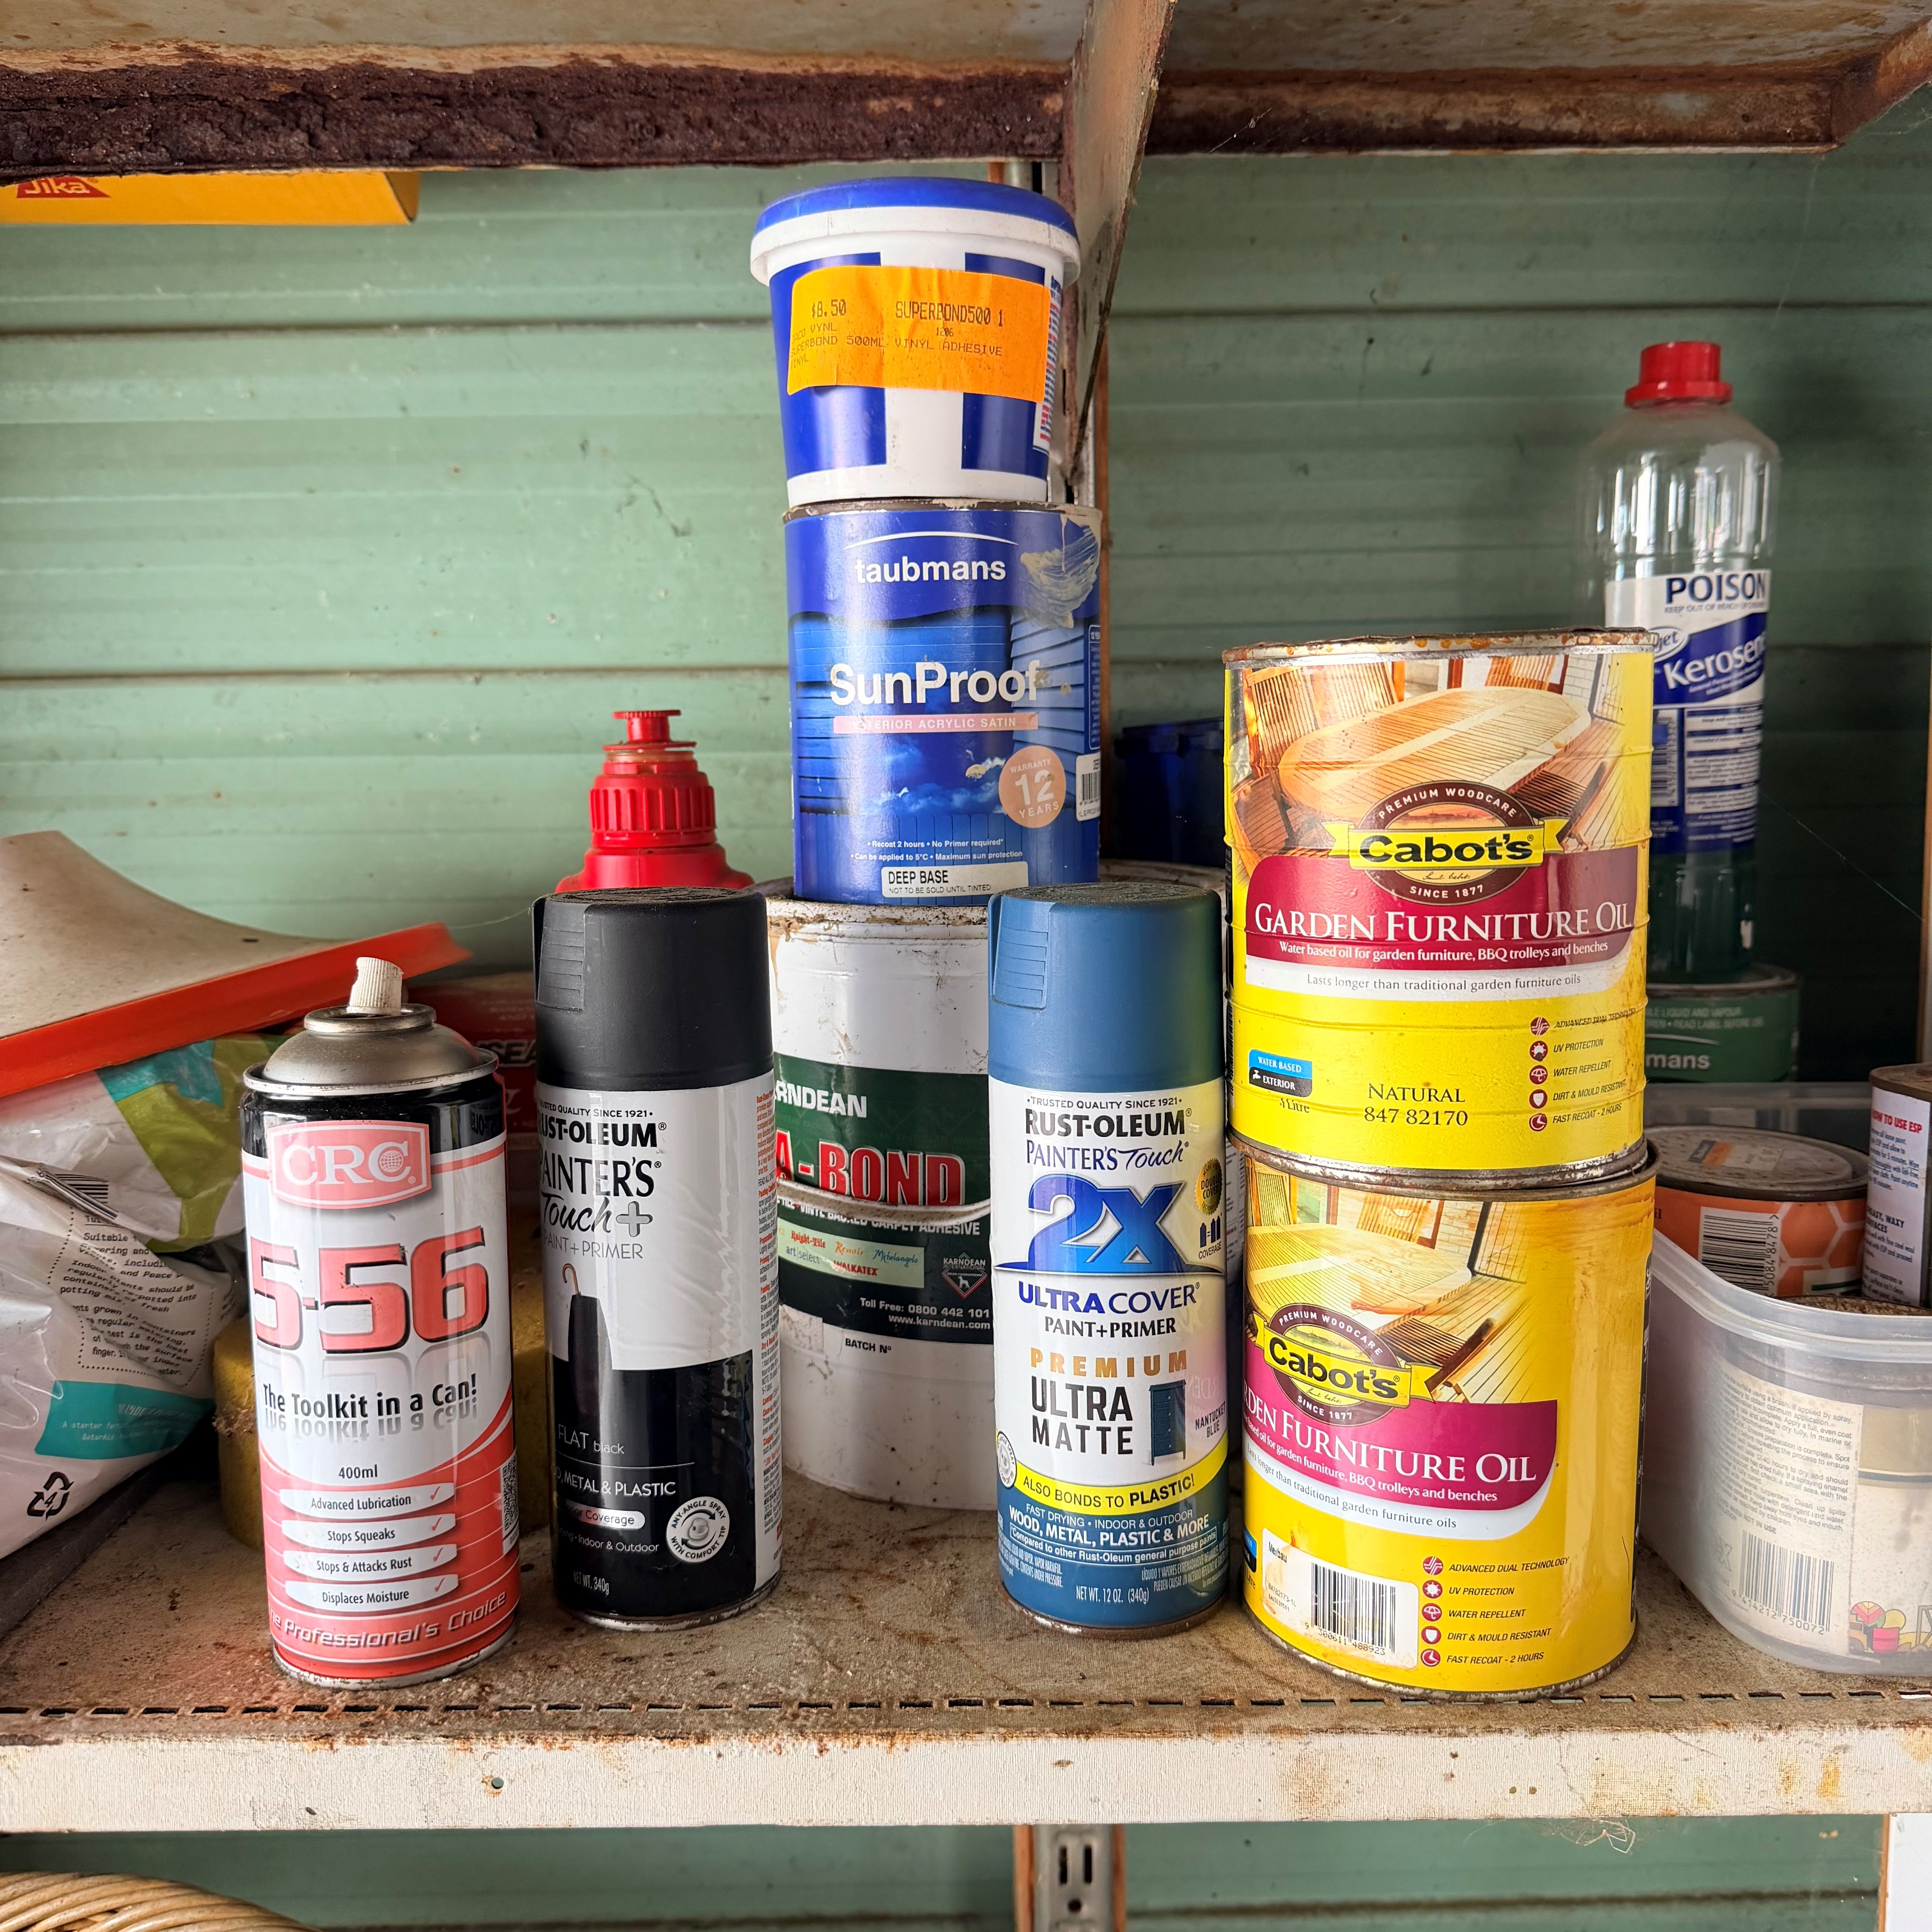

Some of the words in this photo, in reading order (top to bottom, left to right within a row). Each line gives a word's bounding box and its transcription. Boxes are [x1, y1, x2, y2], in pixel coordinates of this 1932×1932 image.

[811, 299, 846, 318] $8.50
[791, 336, 837, 357] SUPERBOND
[846, 335, 885, 347] 500ML
[895, 338, 934, 350] VINYL
[943, 341, 1003, 356] ADHESIVE
[855, 557, 1006, 584] taubmans
[1665, 573, 1765, 604] POISON
[830, 659, 1040, 705] SunProof
[919, 718, 975, 728] ACRYLIC
[980, 718, 1016, 727] SATIN
[1010, 758, 1051, 774] WARRANTY
[1015, 769, 1054, 806] 12
[1018, 801, 1059, 818] YEARS
[1378, 788, 1439, 820] PREMIUM
[1445, 787, 1517, 818] WOODCARE
[1359, 834, 1533, 863] Cabot's
[888, 870, 916, 884] DEEP
[920, 870, 948, 883] BASE
[1409, 884, 1449, 899] SINCE
[1454, 884, 1484, 898] 1877
[1254, 903, 1375, 941] GARDEN
[1385, 911, 1590, 943] FURNITURE
[1596, 902, 1631, 931] OIL
[1307, 974, 1331, 987] Lasts
[1334, 977, 1371, 992] longer
[1373, 979, 1401, 990] than
[1403, 977, 1467, 992] traditional
[1471, 978, 1512, 992] garden
[1515, 975, 1561, 989] furniture
[1565, 973, 1581, 986] oils
[1554, 1044, 1564, 1053] UV
[1565, 1038, 1604, 1051] PROTECTION
[1258, 1056, 1277, 1068] WATER
[1279, 1061, 1302, 1073] BASED
[1553, 1067, 1577, 1076] WATER
[1579, 1060, 1611, 1073] REPELLENT
[1646, 1054, 1710, 1069] mans
[1263, 1075, 1295, 1090] EXTERIOR
[1368, 1083, 1465, 1102] NATURAL
[558, 1104, 590, 1117] QUALITY
[593, 1109, 622, 1118] SINCE
[1031, 1096, 1073, 1109] TRUSTED
[1077, 1100, 1122, 1110] QUALITY
[1125, 1099, 1156, 1109] SINCE
[1158, 1097, 1177, 1106] 1921
[1025, 1108, 1186, 1138] RUST-OLEUM
[1364, 1106, 1399, 1123] 847
[1406, 1109, 1468, 1126] 82170
[1884, 1114, 1893, 1125] TO
[1895, 1118, 1907, 1130] USE
[1909, 1122, 1922, 1133] ESP
[282, 1141, 412, 1186] CRC
[1026, 1140, 1118, 1171] PAINTER'S
[1119, 1140, 1183, 1170] Touch
[1028, 1173, 1186, 1264] 2X
[83, 1233, 128, 1242] Suitable
[834, 1260, 878, 1276] WALKATEX
[873, 1249, 919, 1268] Michelangelo
[943, 1257, 986, 1266] KARNDEAN
[250, 1225, 490, 1354] 5-56
[1019, 1281, 1105, 1314] ULTRA
[1108, 1284, 1197, 1314] COVER
[860, 1297, 876, 1308] Toll
[880, 1301, 904, 1312] Free:
[908, 1305, 937, 1316] 0800
[941, 1307, 963, 1317] 442
[968, 1309, 990, 1318] 101
[98, 1318, 134, 1327] regular
[888, 1315, 990, 1330] www.karndean.com
[92, 1347, 116, 1357] finger.
[846, 1338, 875, 1352] BATCH
[1030, 1348, 1187, 1378] PREMIUM
[1268, 1336, 1398, 1399] Cabot's
[263, 1383, 286, 1412] The
[291, 1394, 368, 1418] Toolkit
[377, 1392, 400, 1416] in
[409, 1393, 424, 1412] a
[432, 1373, 477, 1407] Can!
[1031, 1376, 1133, 1421] ULTRA
[1195, 1401, 1226, 1431] NANTUCKET
[1798, 1406, 1821, 1417] applied
[1823, 1412, 1831, 1420] by
[1833, 1414, 1853, 1424] spray,
[1032, 1415, 1133, 1455] MATTE
[1206, 1426, 1220, 1438] BLUE
[1282, 1410, 1466, 1483] FURNITURE
[1476, 1453, 1537, 1483] OIL
[338, 1465, 378, 1479] 400ml
[1771, 1460, 1788, 1471] hours
[1826, 1477, 1848, 1486] should
[564, 1472, 600, 1494] METAL
[602, 1480, 611, 1495] &
[615, 1482, 676, 1497] PLASTIC
[1023, 1475, 1051, 1497] ALSO
[1055, 1489, 1102, 1508] BONDS
[1106, 1495, 1124, 1508] TO
[1129, 1473, 1195, 1506] PLASTIC!
[311, 1497, 354, 1511] Advanced
[357, 1495, 411, 1510] Lubrication
[586, 1508, 635, 1527] Coverage
[1009, 1504, 1043, 1537] WOOD,
[1046, 1524, 1096, 1547] METAL,
[1100, 1529, 1160, 1546] PLASTIC
[1163, 1530, 1174, 1542] &
[1177, 1513, 1210, 1539] MORE
[327, 1530, 354, 1543] Stops
[355, 1528, 396, 1543] Squeaks
[317, 1559, 340, 1573] Stops
[342, 1561, 350, 1572] &
[352, 1559, 387, 1573] Attacks
[391, 1556, 413, 1569] Rust
[1449, 1564, 1495, 1573] ADVANCED
[1497, 1563, 1519, 1573] DUAL
[1521, 1556, 1570, 1572] TECHNOLOGY
[322, 1592, 363, 1606] Displaces
[367, 1591, 409, 1603] Moisture
[1076, 1587, 1087, 1601] NET
[1089, 1588, 1101, 1602] WT.
[1103, 1588, 1111, 1601] 12
[1113, 1588, 1123, 1603] OZ.
[1128, 1587, 1150, 1605] (340g)
[1449, 1587, 1461, 1596] UV
[1462, 1587, 1514, 1596] PROTECTION
[285, 1618, 440, 1648] Professional's
[447, 1590, 506, 1631] Choice
[1742, 1596, 1778, 1621] 414212
[1781, 1615, 1825, 1635] 750072
